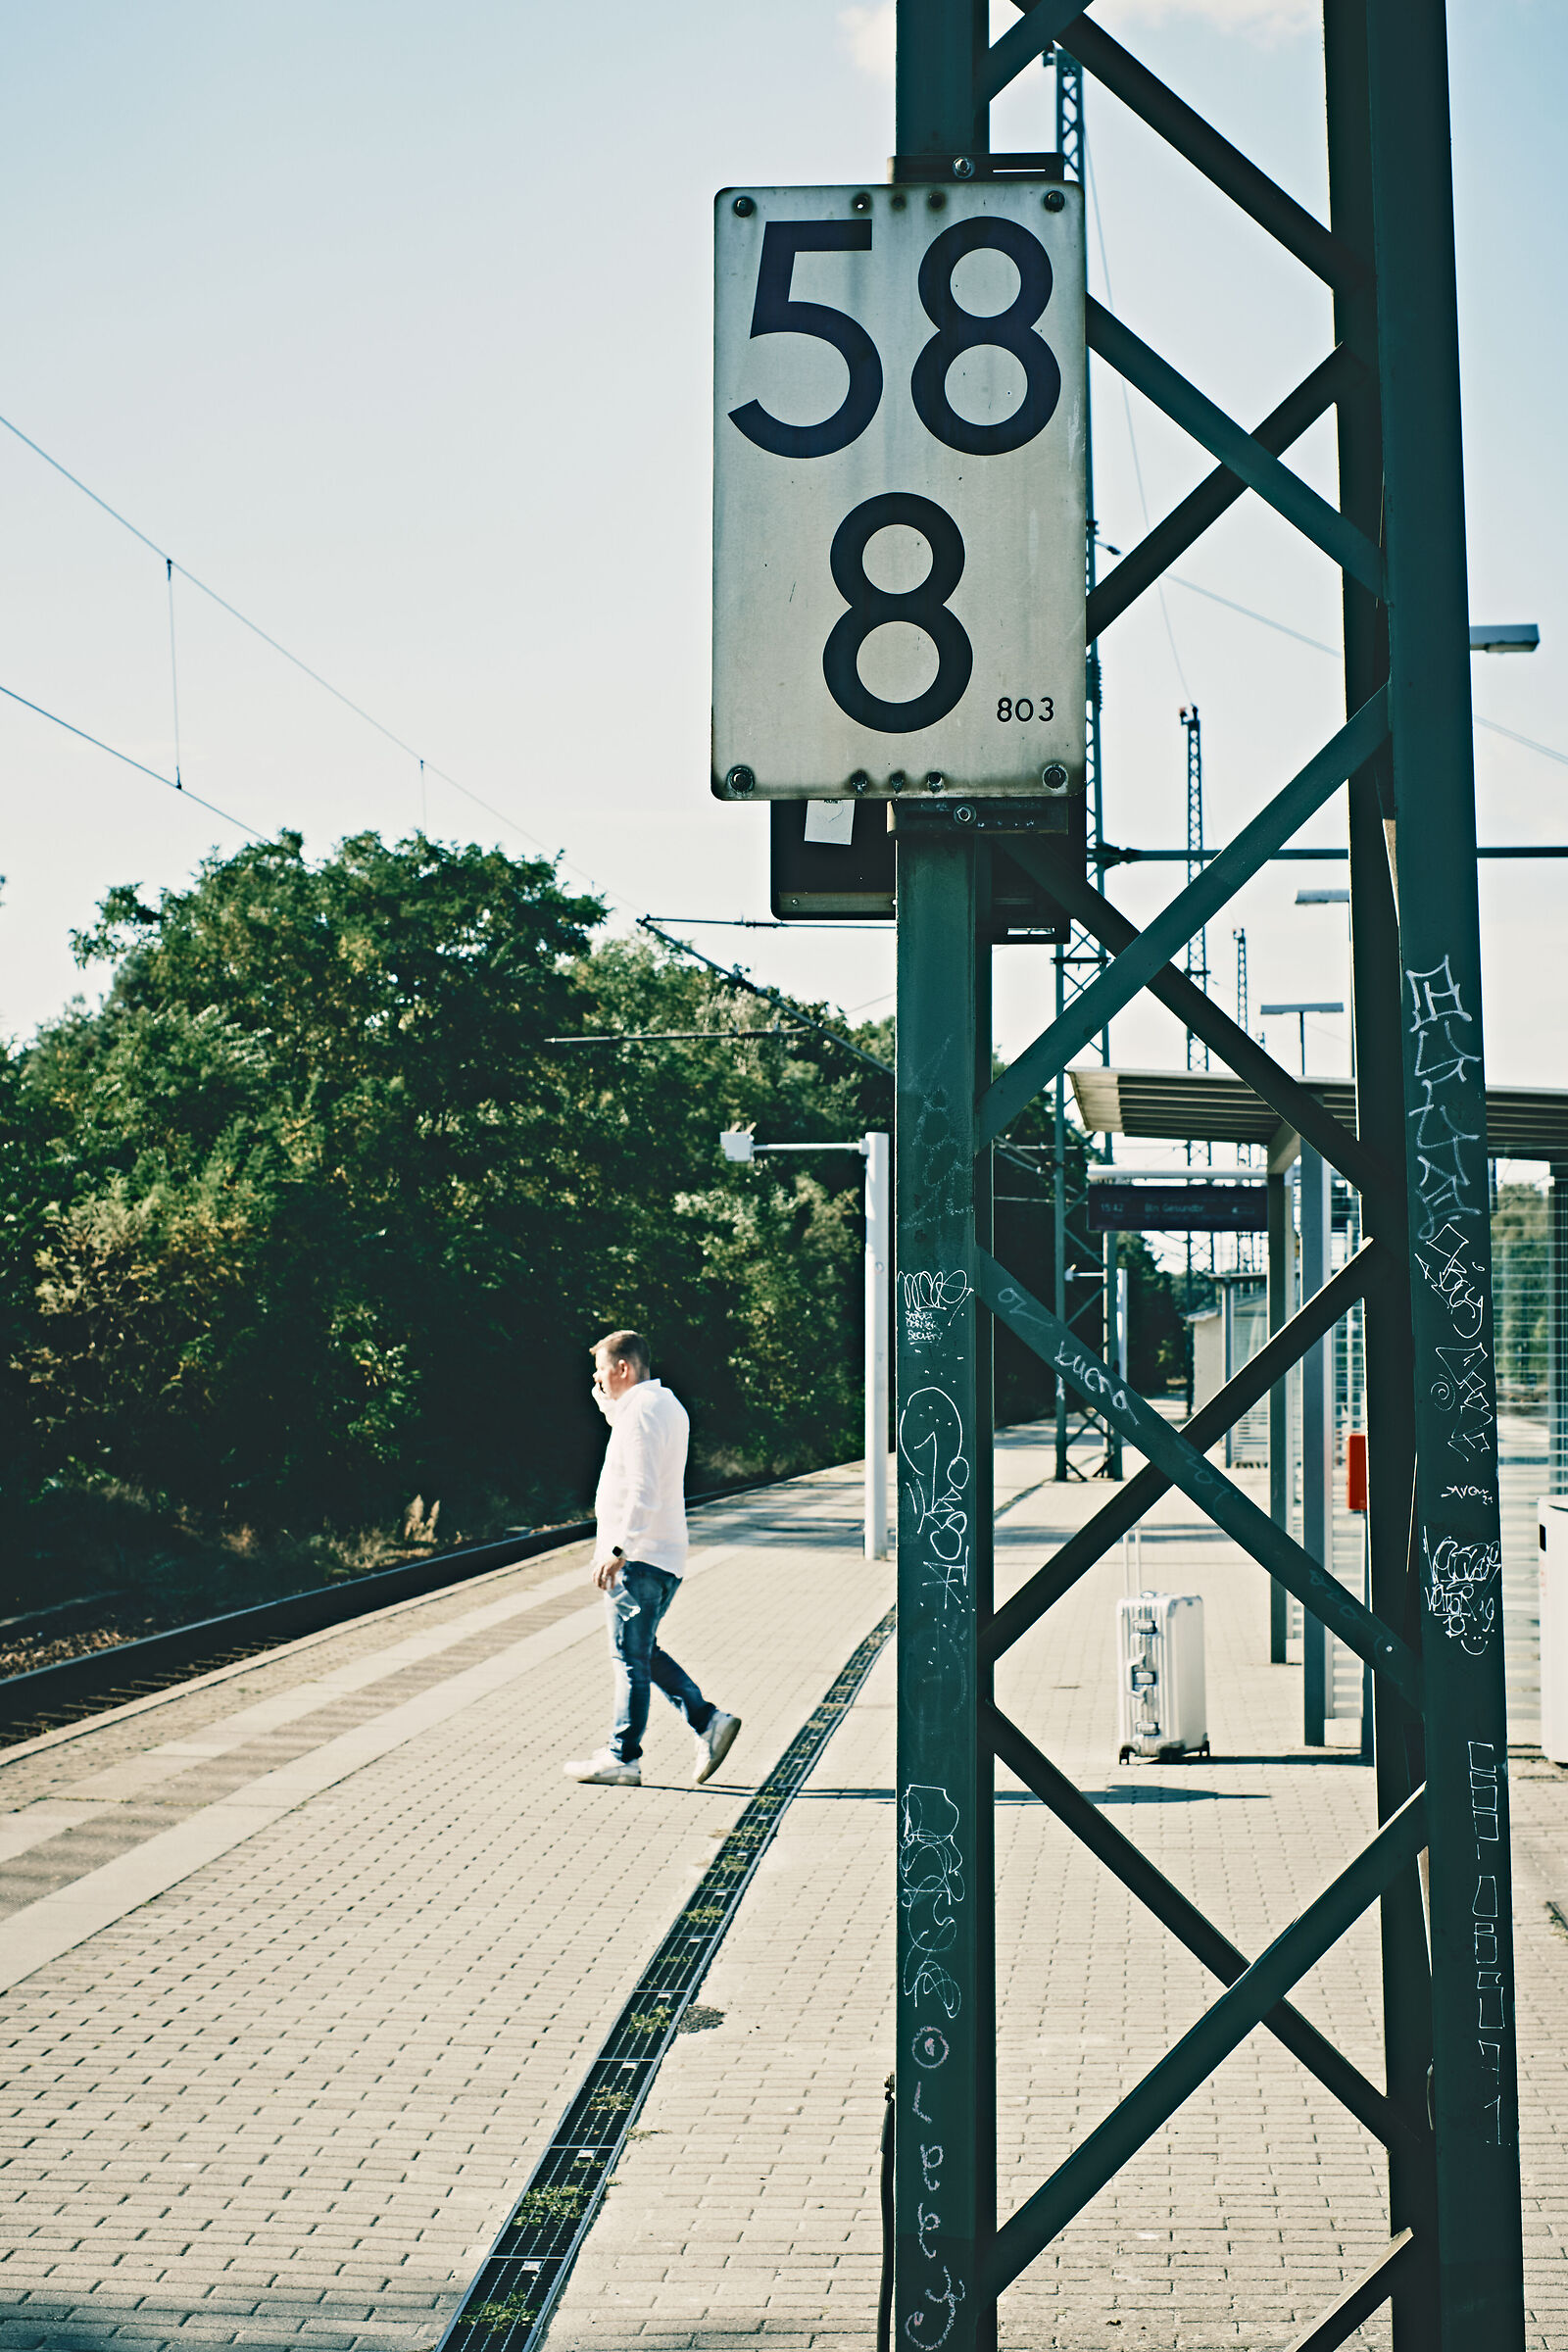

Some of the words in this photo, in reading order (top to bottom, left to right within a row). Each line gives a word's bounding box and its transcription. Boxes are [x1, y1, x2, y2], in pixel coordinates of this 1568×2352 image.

[728, 217, 1061, 459] 58
[823, 492, 973, 734] 8
[997, 697, 1055, 722] 803
